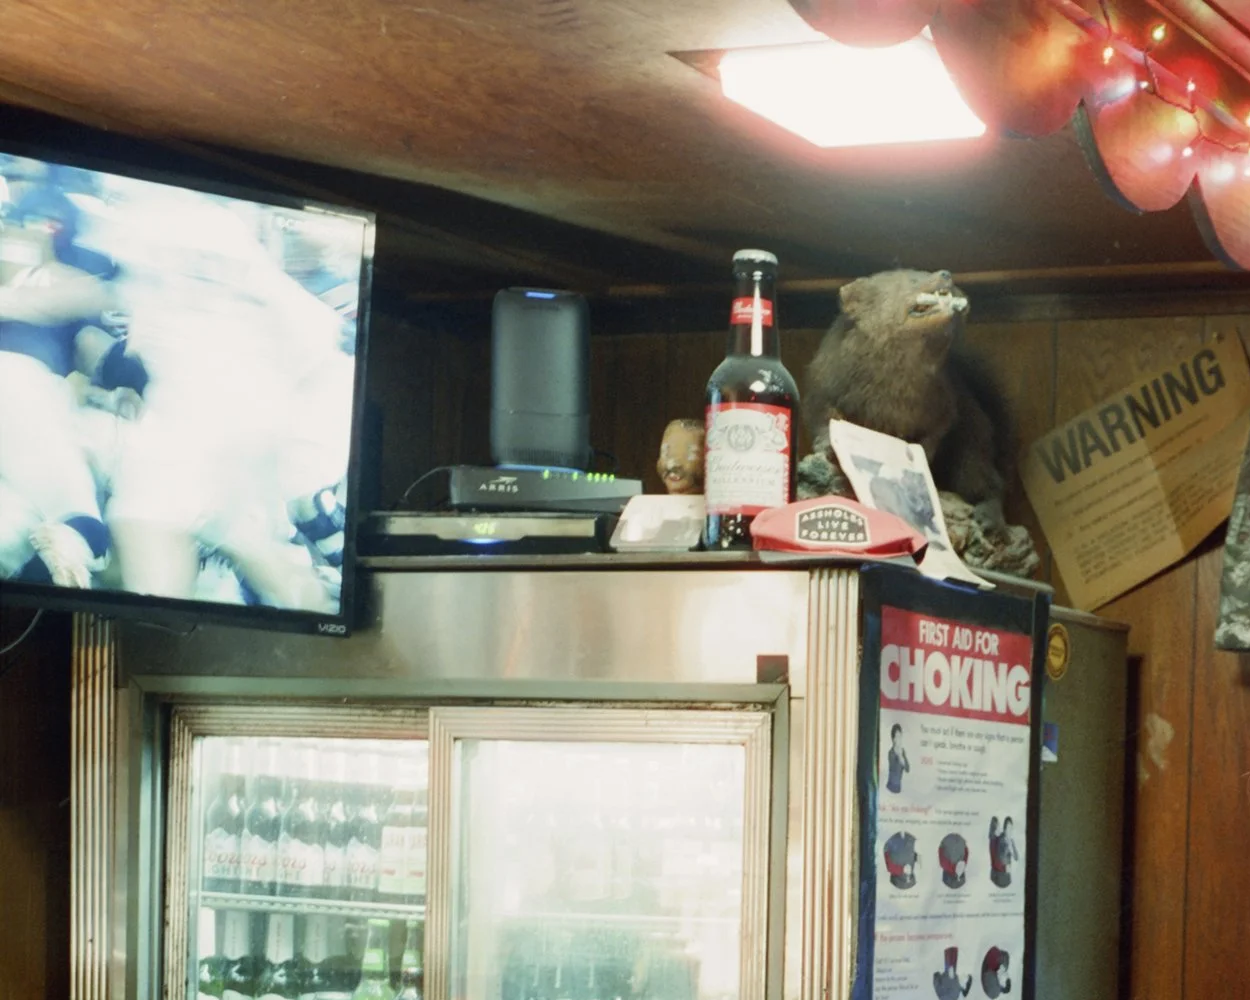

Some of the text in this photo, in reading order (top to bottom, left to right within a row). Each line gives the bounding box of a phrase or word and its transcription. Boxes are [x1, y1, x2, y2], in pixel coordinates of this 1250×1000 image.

[1036, 348, 1227, 484] WARNING
[479, 483, 519, 494] ARRIS
[801, 509, 864, 527] ASSHOLES
[817, 520, 849, 531] LIVE
[800, 529, 865, 541] FOREVER
[318, 623, 347, 634] VIZIO
[919, 619, 1000, 657] FIRST AID FOR
[879, 643, 1031, 717] CHOKING
